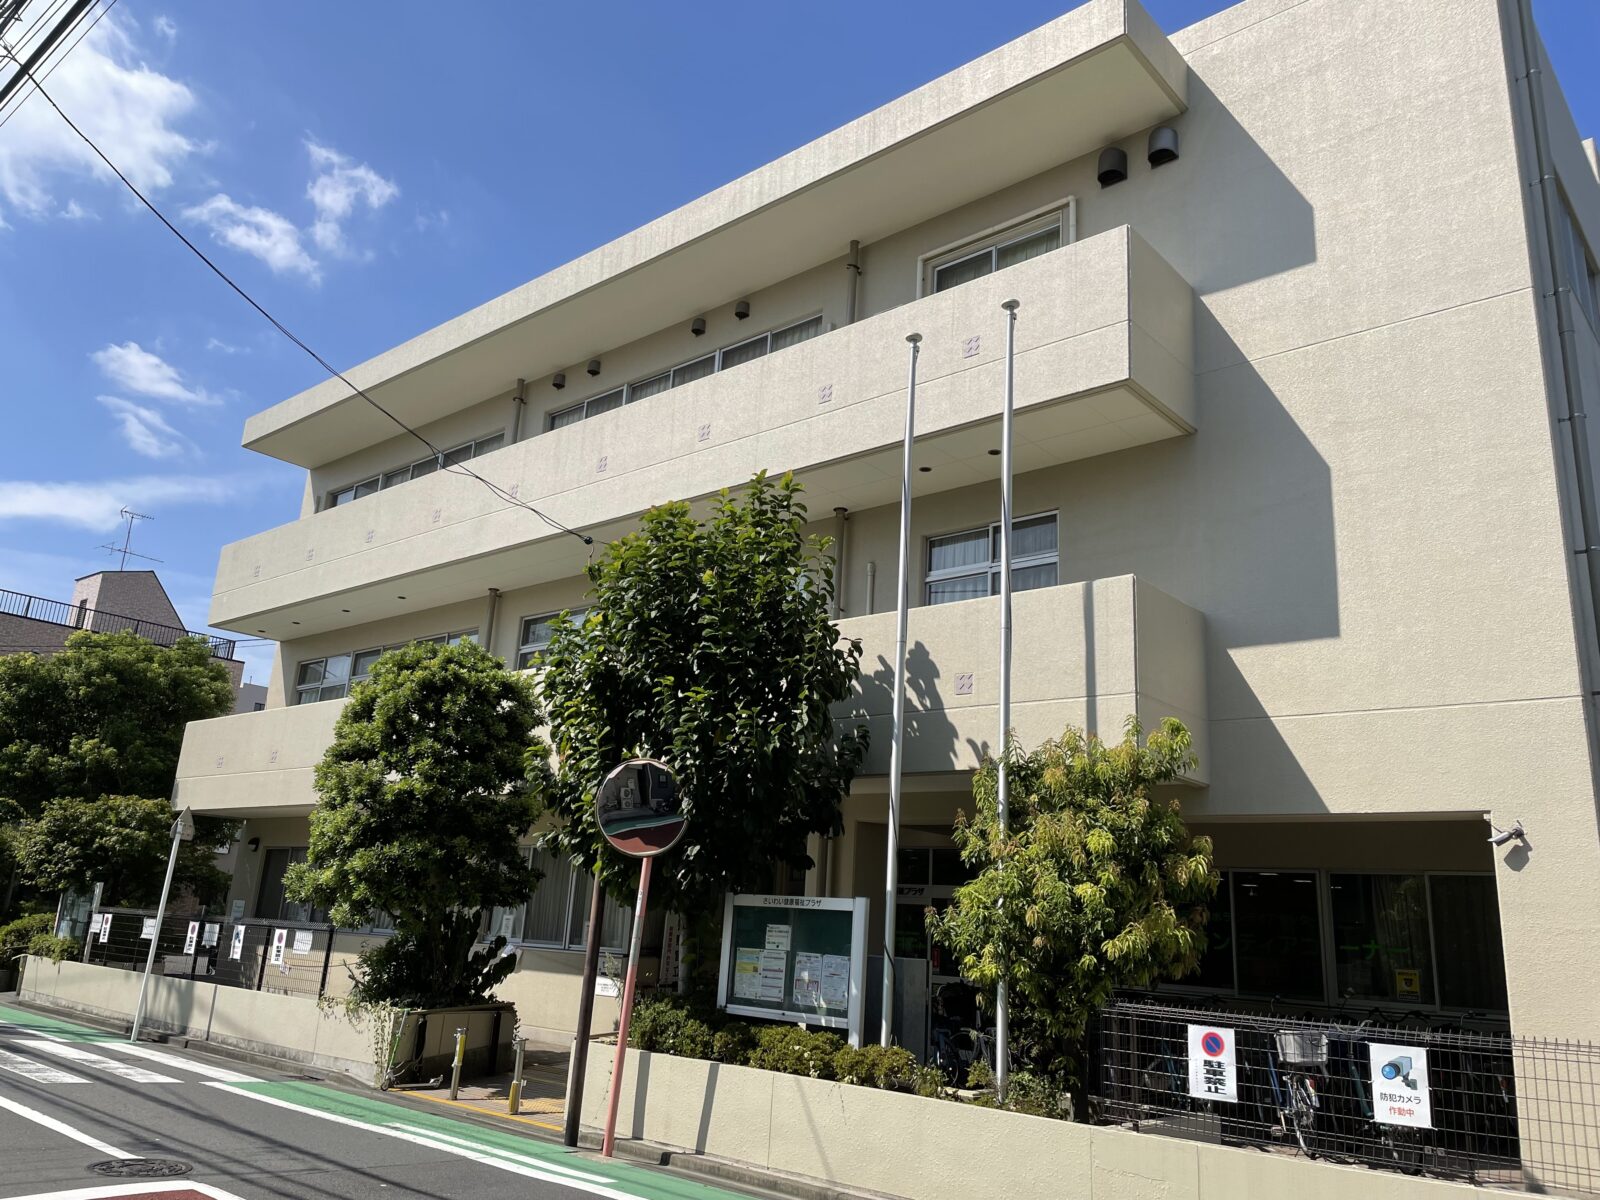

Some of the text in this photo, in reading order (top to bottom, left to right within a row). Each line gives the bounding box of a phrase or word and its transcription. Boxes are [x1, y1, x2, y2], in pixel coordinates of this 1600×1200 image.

[762, 897, 822, 907] さいわい健康福祉プラザ
[1203, 1059, 1227, 1095] 駐車禁止
[1379, 1092, 1422, 1105] 防犯カメラ
[1388, 1105, 1415, 1118] 作動中
